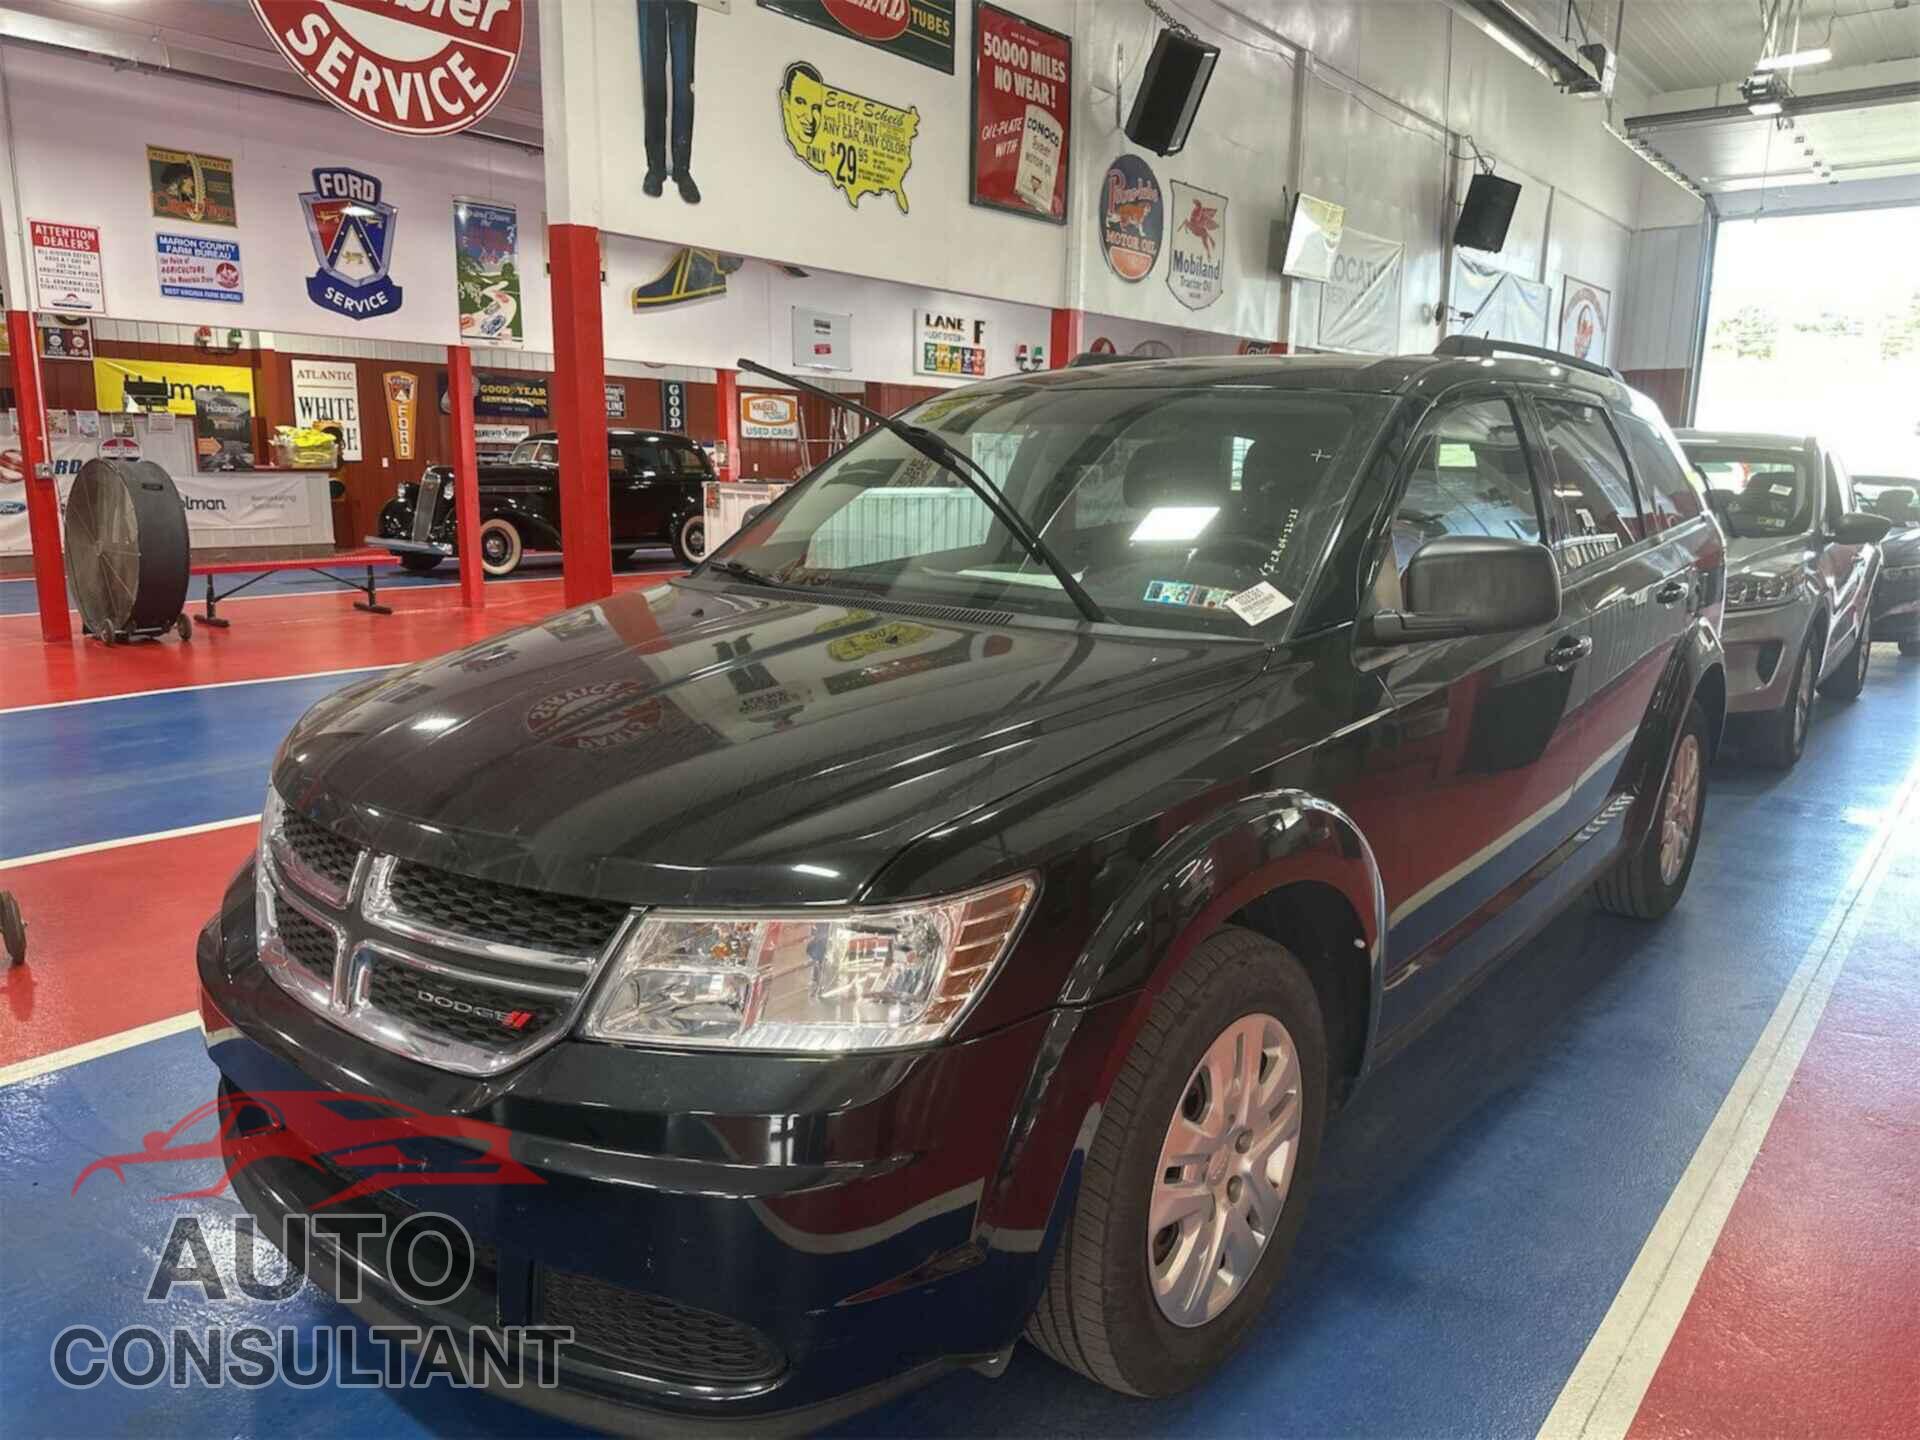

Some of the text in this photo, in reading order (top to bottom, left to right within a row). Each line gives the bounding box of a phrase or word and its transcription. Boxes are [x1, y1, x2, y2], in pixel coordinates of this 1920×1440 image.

[911, 7, 950, 36] TUBES
[285, 13, 488, 122] SERVICE
[1031, 51, 1066, 83] MILES
[994, 65, 1056, 109] NO WEAR!
[824, 91, 858, 113] Earl
[823, 121, 840, 137] ANY
[863, 134, 880, 149] ANY
[880, 137, 907, 155] COLOR
[854, 118, 877, 136] PAINT
[1026, 117, 1060, 148] CONOCO
[806, 145, 825, 165] ONLY
[319, 173, 375, 202] FORD
[35, 224, 95, 240] ATTENTION
[43, 235, 90, 250] DEALERS
[159, 236, 236, 251] MARION COUNTY
[1106, 229, 1136, 248] MOTOR
[166, 244, 231, 260] FARM BUREAU
[1172, 249, 1220, 280] Mobiland
[324, 286, 389, 313] SERVICE
[926, 313, 986, 344] LANE F
[296, 369, 353, 381] ATLANTIC
[480, 385, 546, 397] GOOD YEAR
[298, 396, 356, 421] WHITE
[668, 384, 682, 428] GOOD
[746, 427, 794, 436] USED CARS
[417, 989, 513, 1026] DODGE
